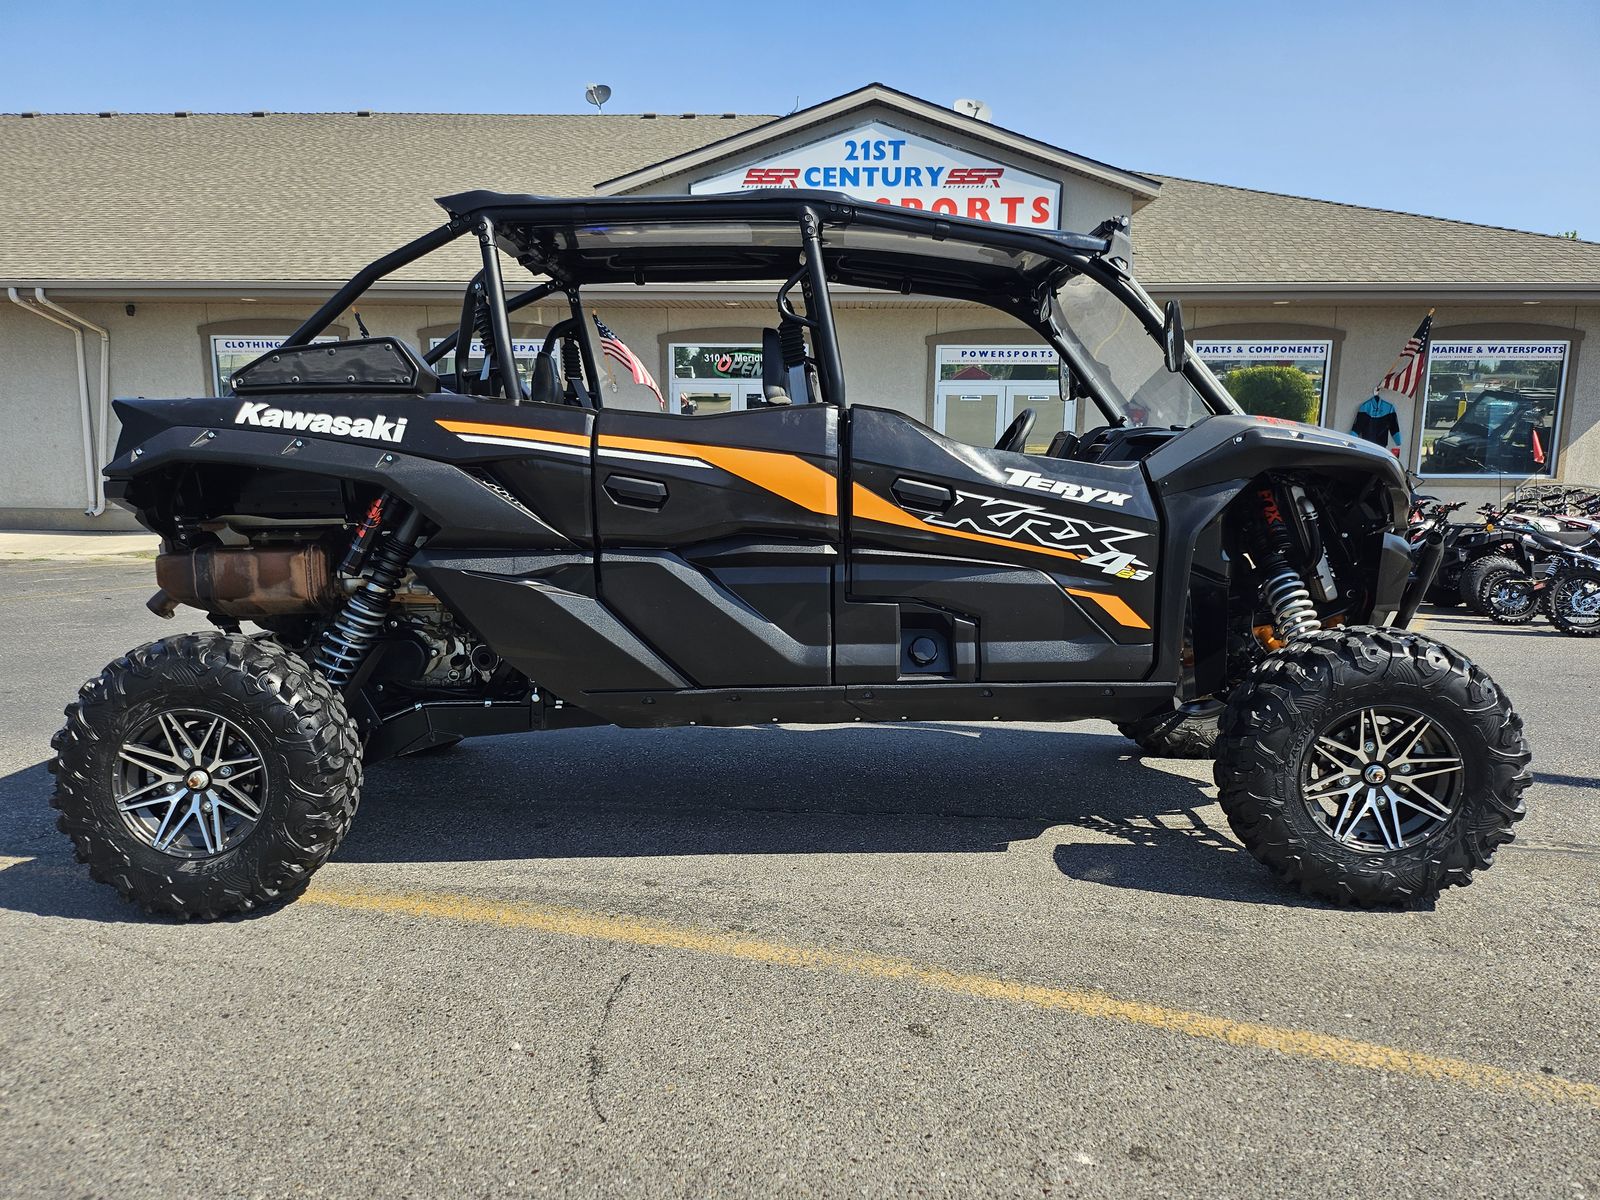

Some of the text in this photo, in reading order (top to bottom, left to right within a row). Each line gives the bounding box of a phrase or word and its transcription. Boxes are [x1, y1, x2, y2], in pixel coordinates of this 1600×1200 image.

[845, 140, 906, 161] 21ST
[742, 168, 801, 188] SSR
[804, 167, 945, 187] CENTURY
[944, 168, 1005, 188] SSR
[875, 196, 1050, 224] ORTS
[225, 341, 282, 349] CLOTHING
[961, 350, 1053, 358] POWERSPORTS
[1196, 346, 1325, 354] PARTS & COMPONENTS
[1432, 346, 1473, 354] MARINE
[1487, 346, 1564, 354] WATERSPORTS
[704, 353, 720, 362] 310
[717, 355, 763, 376] OPEN
[235, 401, 408, 443] Kawasaki
